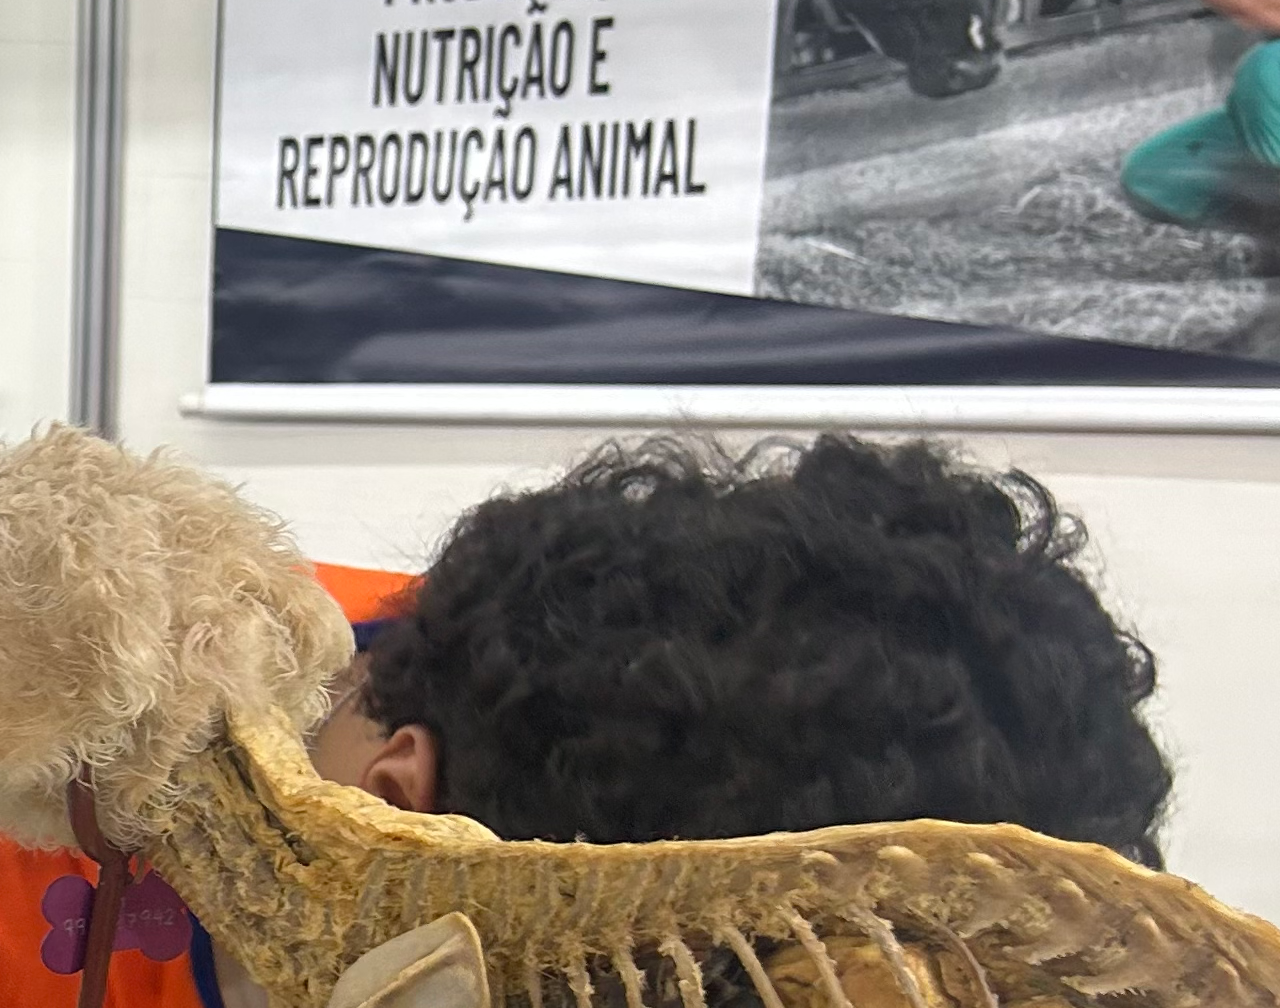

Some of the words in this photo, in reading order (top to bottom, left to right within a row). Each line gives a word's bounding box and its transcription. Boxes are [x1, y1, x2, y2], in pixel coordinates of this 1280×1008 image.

[372, 0, 575, 112] NUTRIÇÃO
[588, 17, 614, 96] E
[276, 107, 537, 222] REPRODUÇÃO
[548, 118, 707, 200] ANIMAL
